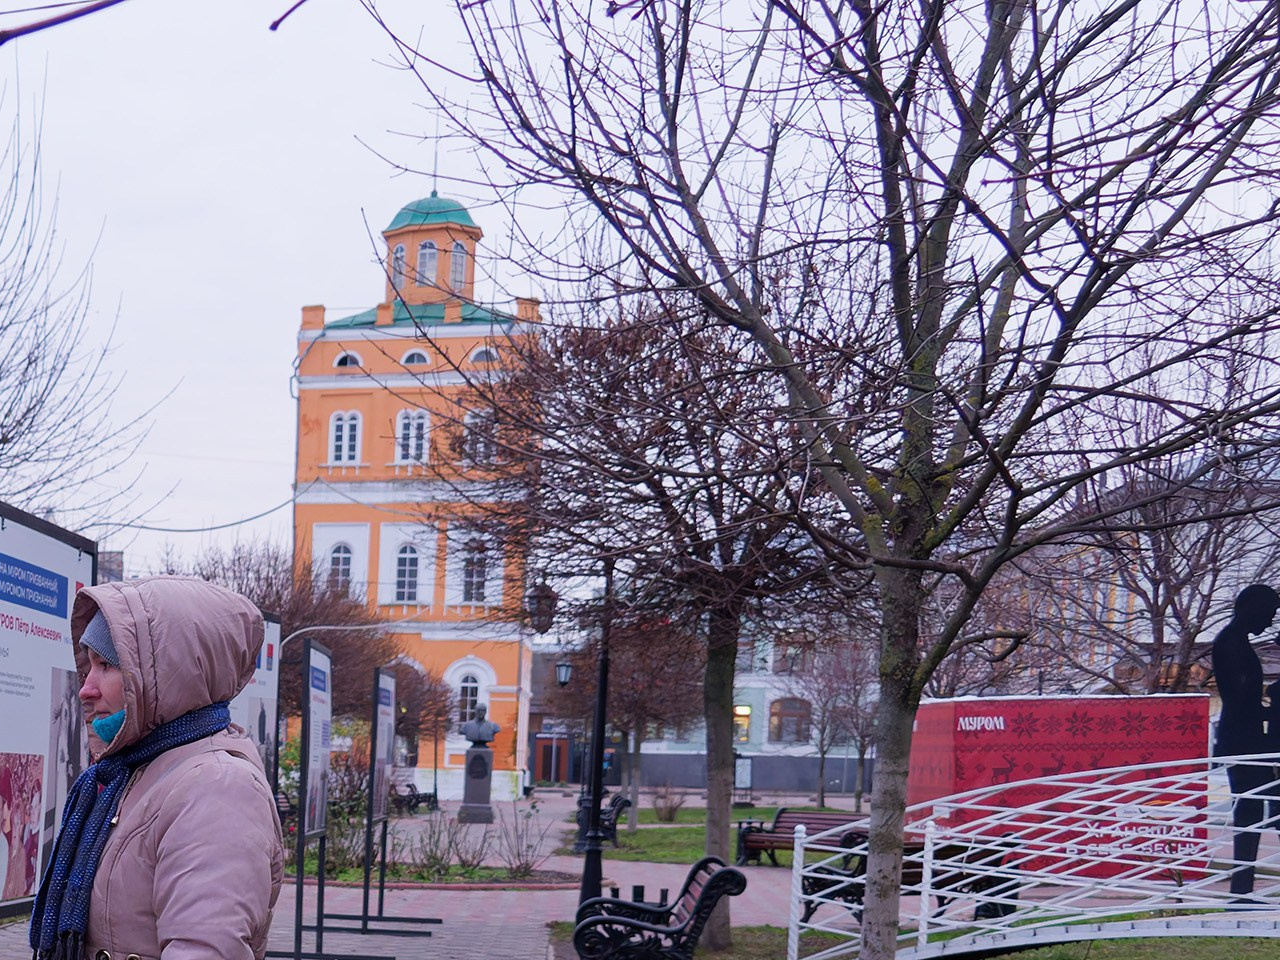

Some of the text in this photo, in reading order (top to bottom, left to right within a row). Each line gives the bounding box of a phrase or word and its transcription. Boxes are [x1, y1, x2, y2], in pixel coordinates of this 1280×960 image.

[0, 561, 7, 576] НА
[7, 564, 27, 582] МУРОМ
[0, 580, 26, 599] МУРОМОМ
[957, 715, 1005, 731] МУРОМ
